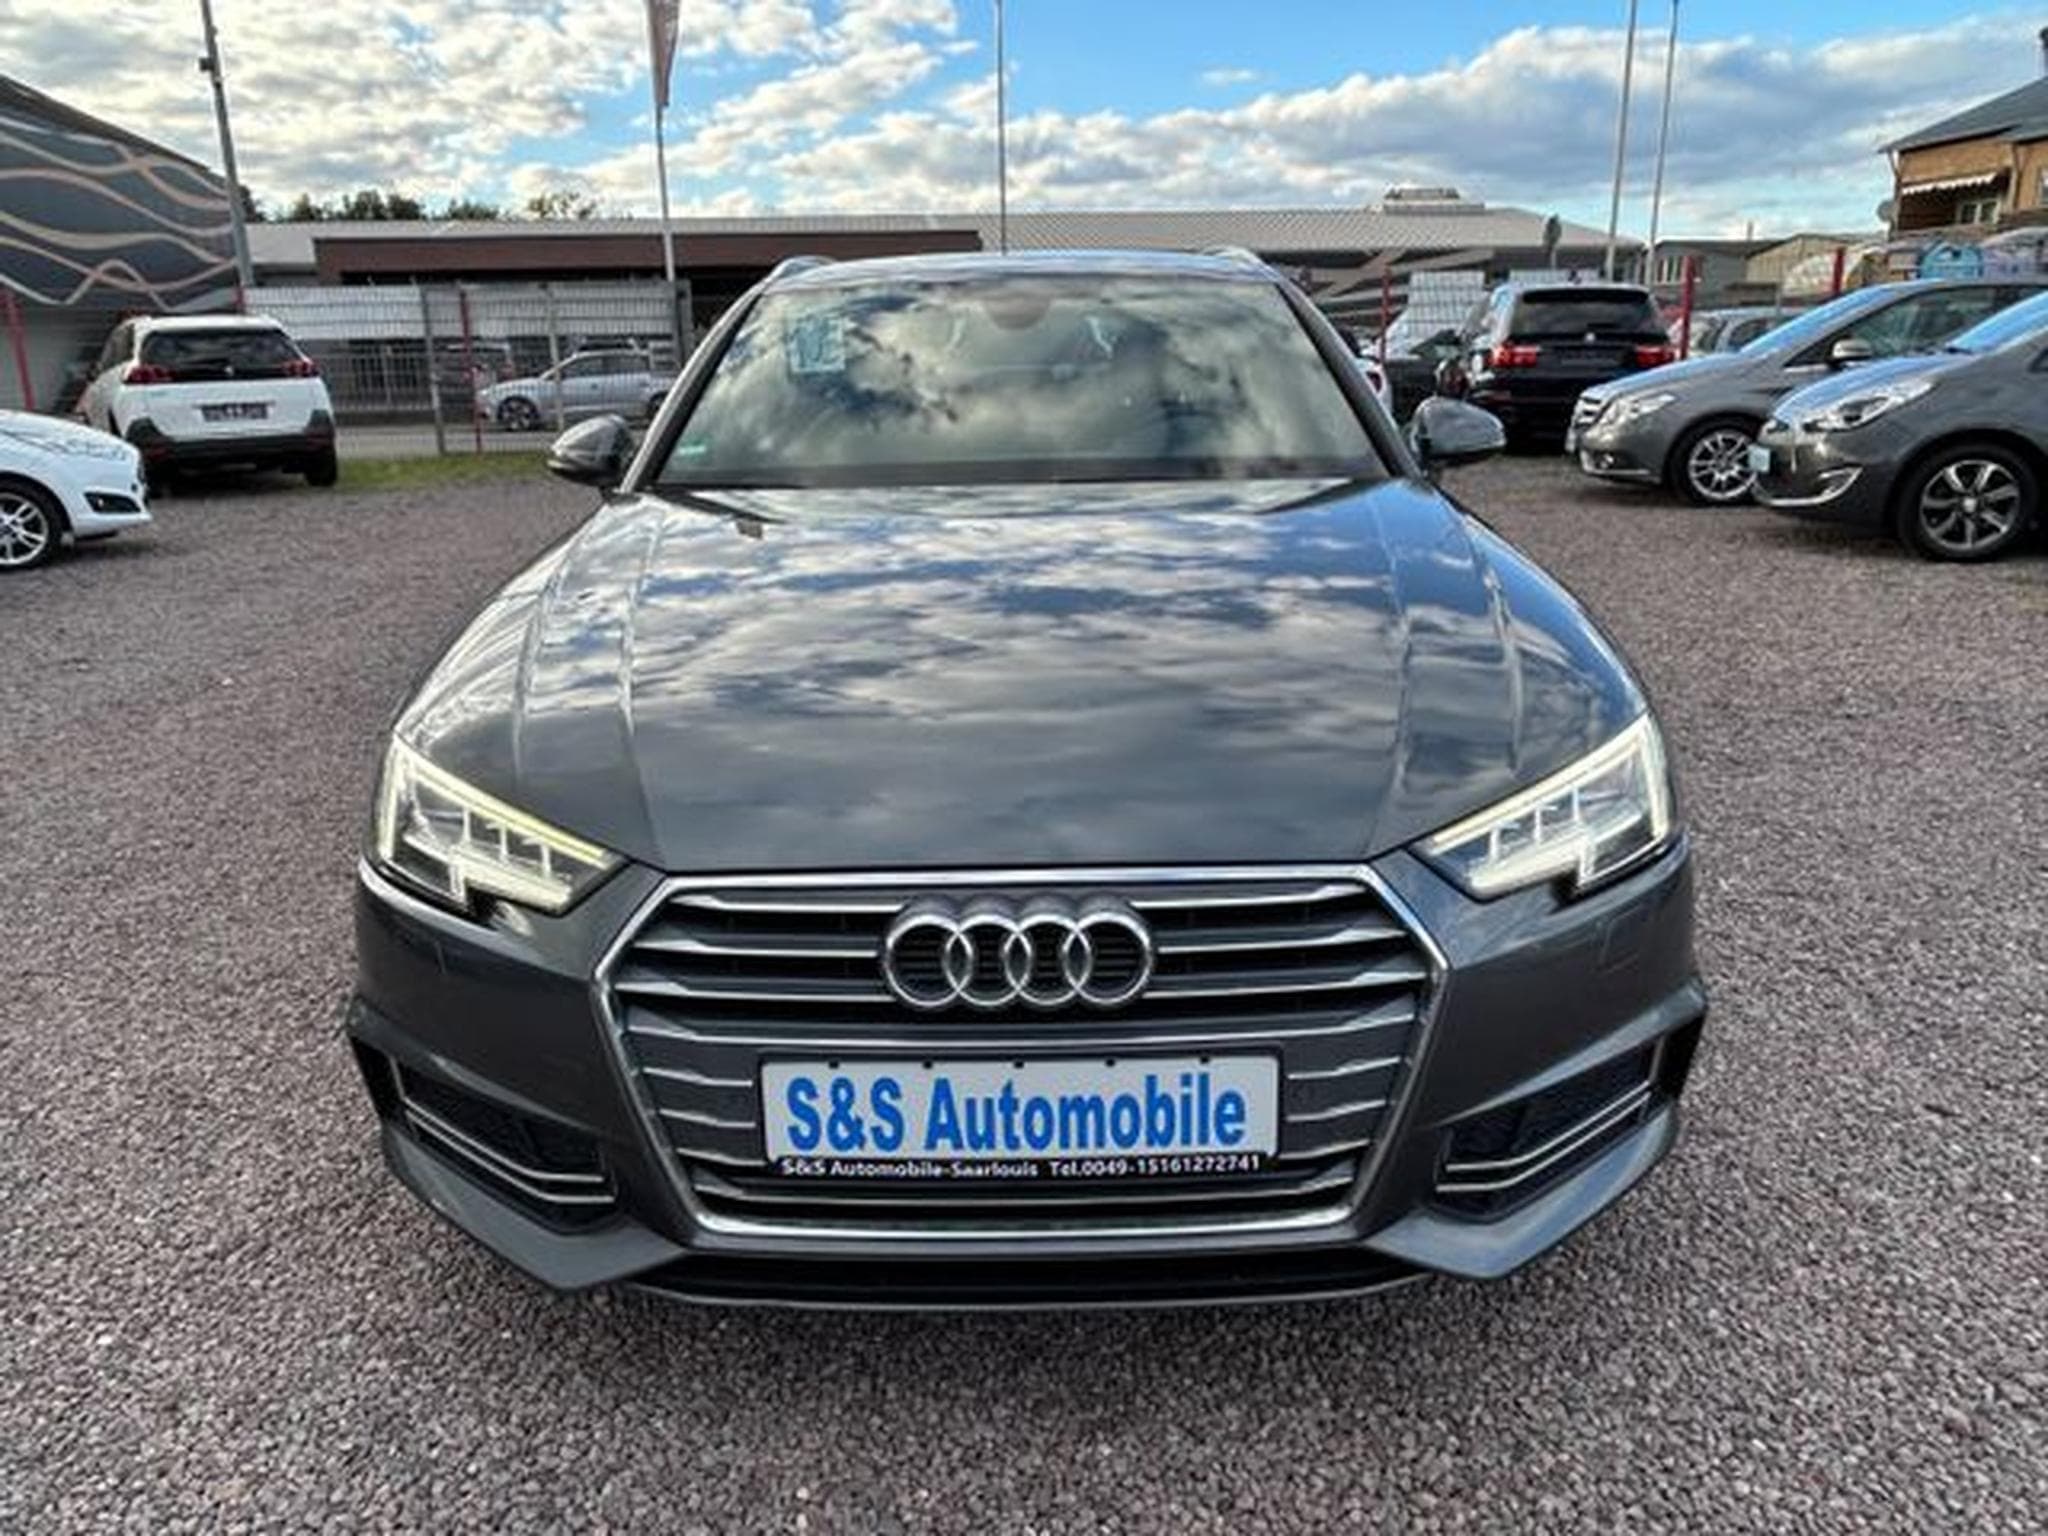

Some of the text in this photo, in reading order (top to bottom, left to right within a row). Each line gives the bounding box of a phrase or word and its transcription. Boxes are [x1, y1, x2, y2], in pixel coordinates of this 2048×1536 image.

[786, 1073, 1247, 1152] S&S Automobile
[782, 1158, 827, 1176] S&S
